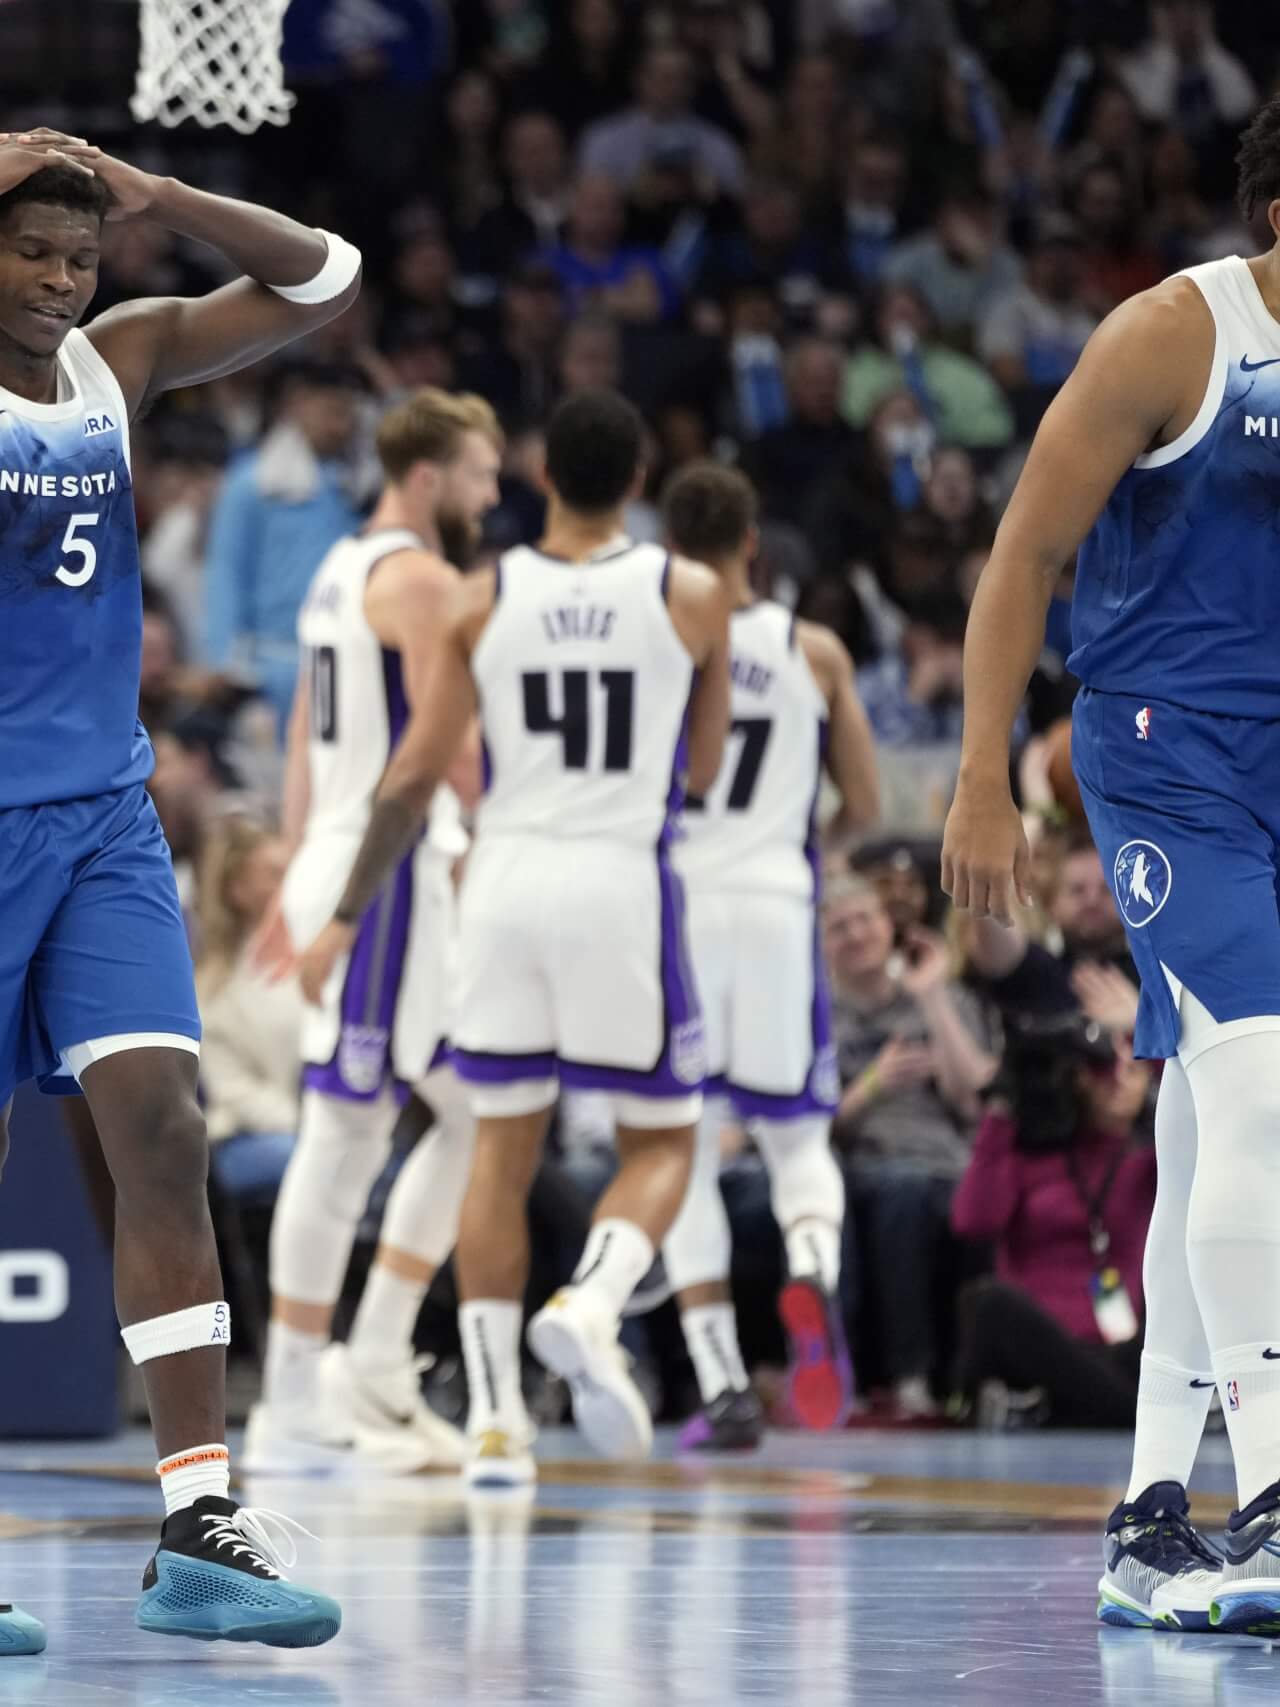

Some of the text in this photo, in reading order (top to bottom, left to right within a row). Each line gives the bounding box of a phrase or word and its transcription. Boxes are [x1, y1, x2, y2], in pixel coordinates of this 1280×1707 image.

[55, 513, 100, 587] 5
[521, 668, 636, 772] 41
[214, 1303, 227, 1323] 5
